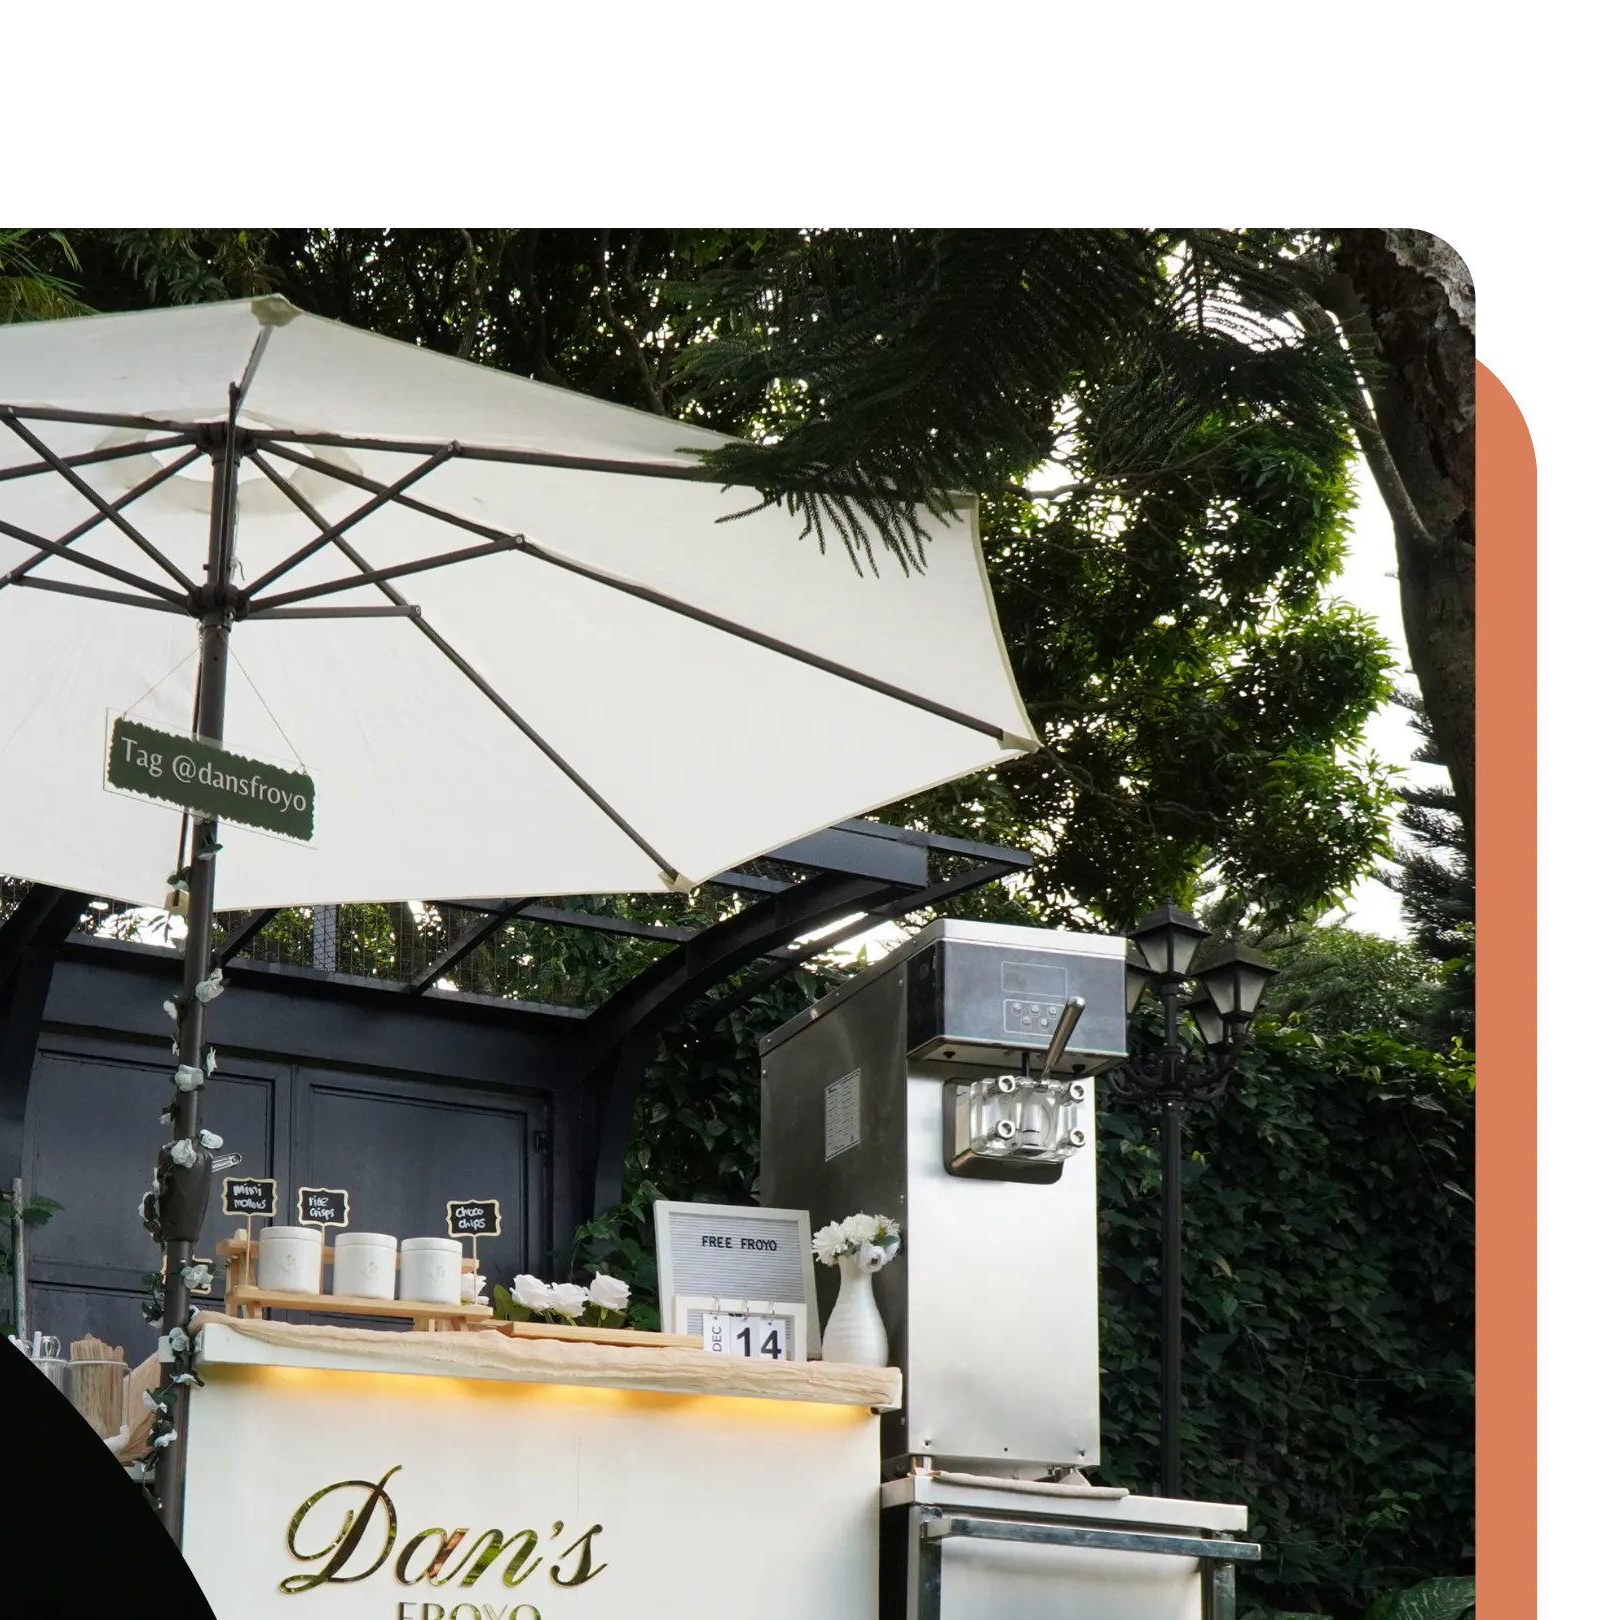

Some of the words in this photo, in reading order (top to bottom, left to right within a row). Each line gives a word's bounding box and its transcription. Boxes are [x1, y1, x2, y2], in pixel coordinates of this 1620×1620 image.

[120, 736, 163, 778] Tag
[171, 755, 307, 813] @dansfroyo
[232, 1183, 262, 1197] mini
[308, 1194, 329, 1207] rice
[455, 1206, 485, 1218] choco
[458, 1218, 486, 1231] chips
[702, 1235, 733, 1249] FREE
[740, 1238, 777, 1251] FROYO
[711, 1326, 723, 1352] DEC
[278, 1464, 609, 1594] Dan's
